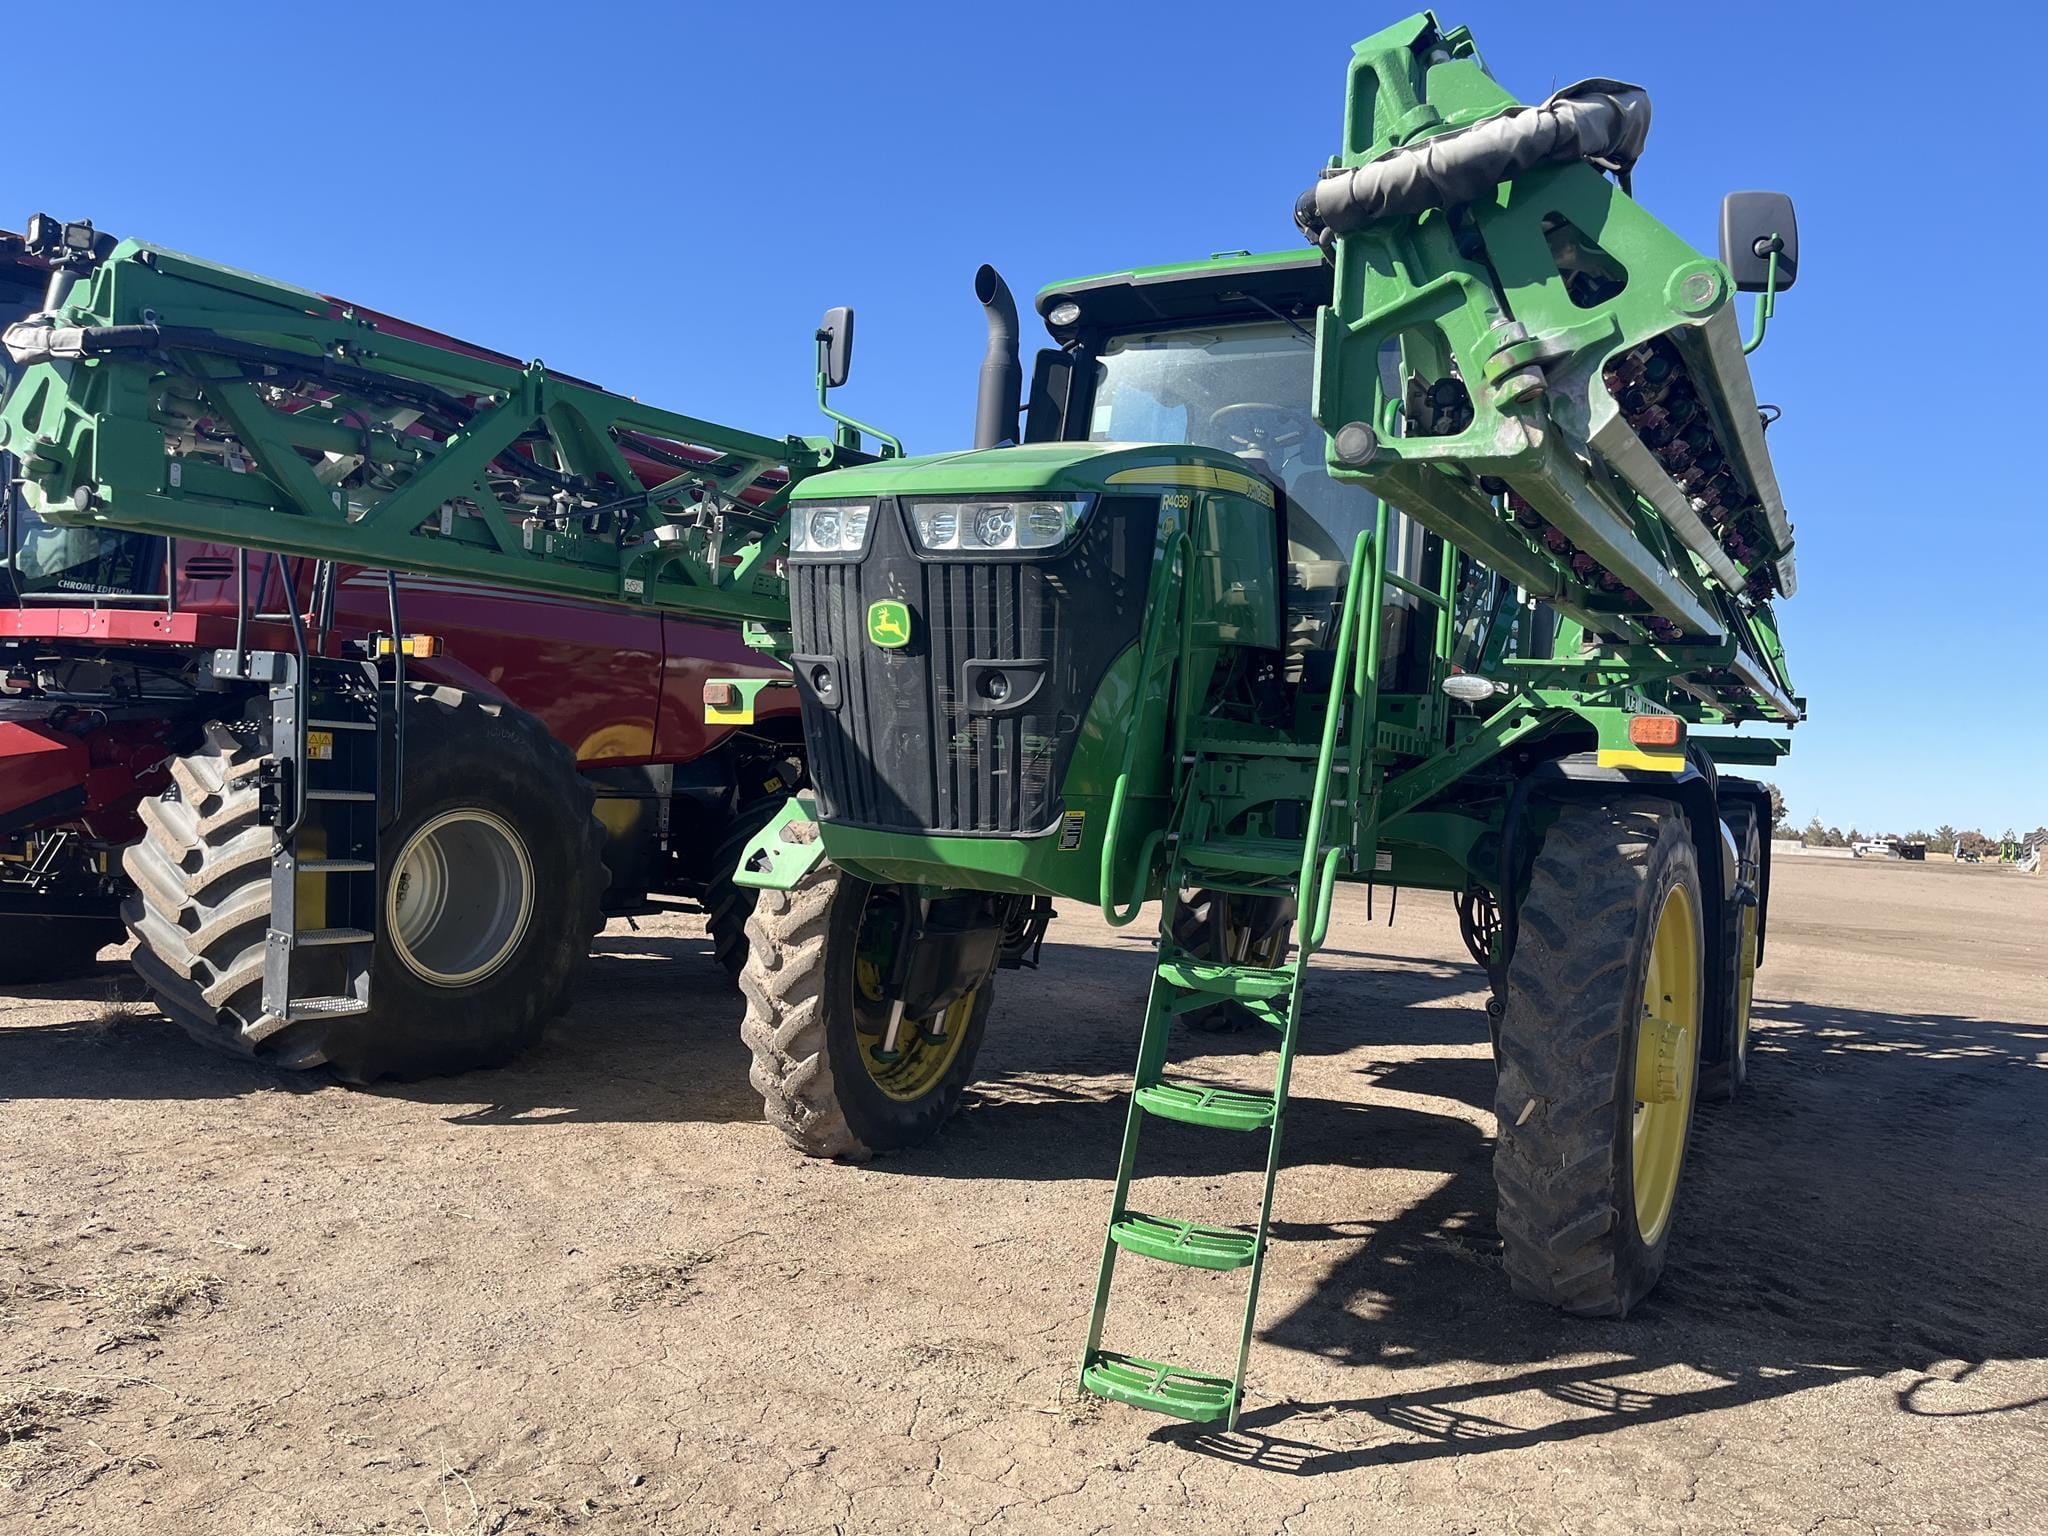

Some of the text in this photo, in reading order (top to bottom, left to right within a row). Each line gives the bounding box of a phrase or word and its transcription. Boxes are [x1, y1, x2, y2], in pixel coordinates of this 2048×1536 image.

[1162, 494, 1189, 510] R4038
[58, 580, 132, 594] CHROME EDITION
